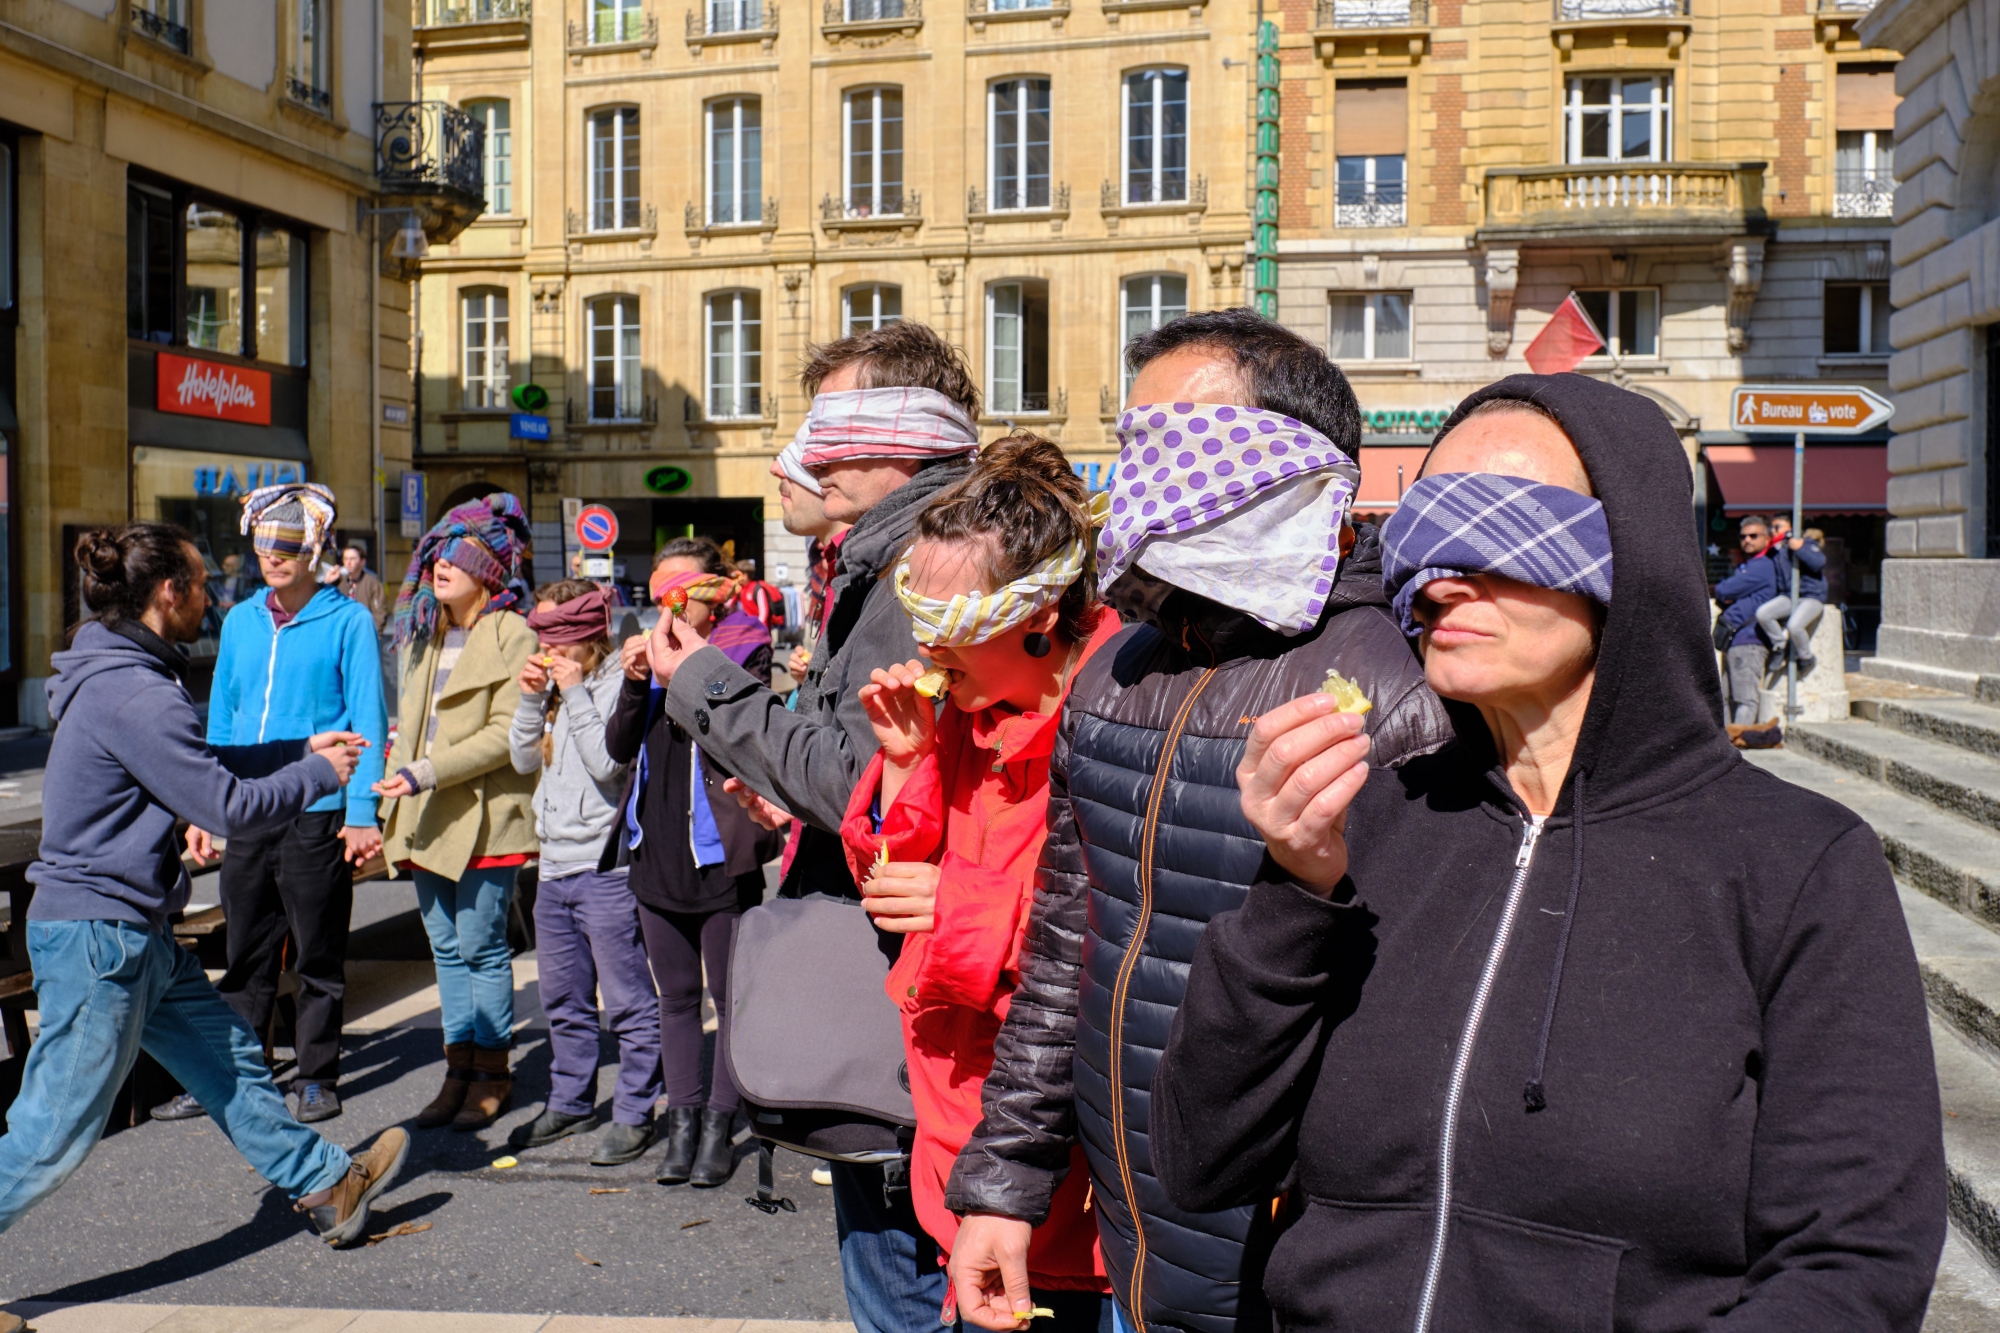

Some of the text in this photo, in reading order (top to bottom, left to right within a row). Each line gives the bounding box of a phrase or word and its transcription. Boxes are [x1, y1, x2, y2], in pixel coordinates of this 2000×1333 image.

[178, 362, 255, 414] Hotelplan
[1762, 402, 1803, 418] Bureau
[1829, 404, 1857, 419] vote
